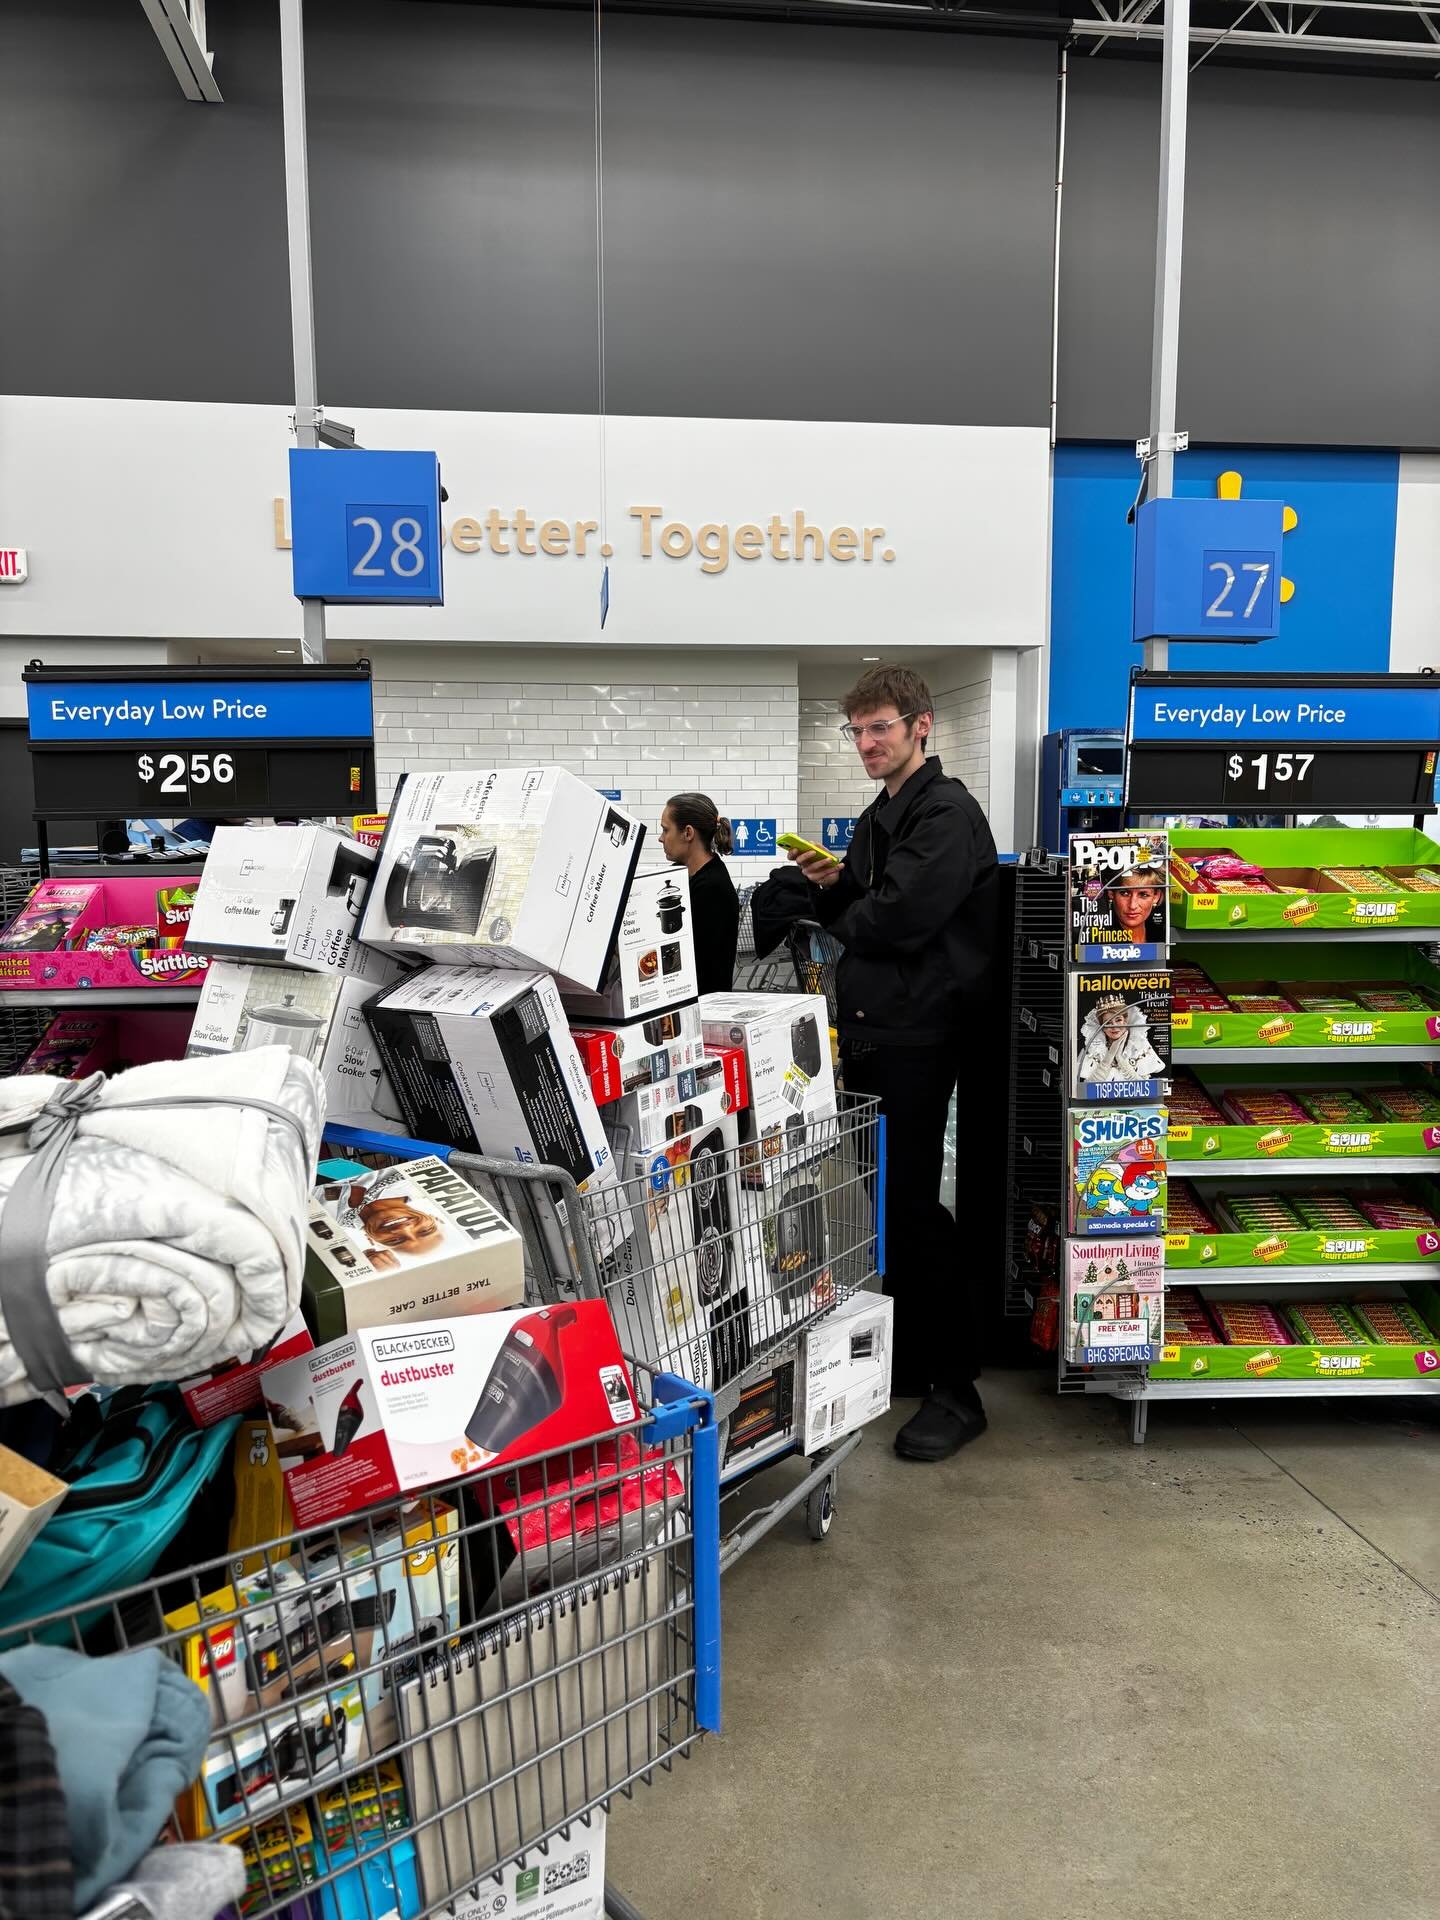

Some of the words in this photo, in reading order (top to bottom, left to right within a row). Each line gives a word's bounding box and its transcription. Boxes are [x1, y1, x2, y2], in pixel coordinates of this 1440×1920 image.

[352, 516, 425, 577] 28
[442, 508, 613, 557] etter.
[630, 506, 896, 573] Together.
[1206, 561, 1270, 618] 27
[51, 699, 155, 726] Everyday
[162, 701, 206, 720] Low
[212, 699, 267, 719] Price
[1154, 703, 1246, 728] Everyday
[1252, 704, 1291, 723] Low
[1297, 703, 1346, 723] Price
[475, 773, 497, 820] Cafeteria
[1073, 837, 1164, 877] People
[587, 894, 600, 923] Coffee
[594, 863, 608, 893] Maker
[1080, 897, 1098, 912] The
[1197, 898, 1215, 906] NEW
[224, 906, 241, 914] Coffee
[242, 907, 261, 916] Maker
[1283, 902, 1319, 920] Starburst
[1351, 915, 1372, 924] FRUIT
[1373, 915, 1399, 924] CHEWS
[302, 905, 319, 951] MAINSTAYS
[623, 927, 641, 936] Cooker
[1080, 927, 1092, 943] of
[1092, 927, 1133, 943] Princess
[317, 928, 333, 962] 12-Cup
[327, 928, 344, 966] Coffee
[337, 932, 353, 969] Maker
[1102, 945, 1141, 960] People
[140, 954, 209, 976] Skittles
[1080, 975, 1170, 992] halloween
[193, 1030, 208, 1039] Slow
[208, 1032, 229, 1043] Cooker
[1259, 1022, 1294, 1038] Starburst
[1327, 1035, 1348, 1043] FRUIT
[1349, 1034, 1376, 1043] CHEWS
[344, 1054, 365, 1066] Slow
[599, 1040, 609, 1068] FOREMAN
[337, 1064, 366, 1078] Cooker
[569, 1053, 585, 1092] Cookware
[754, 1070, 763, 1078] Air
[762, 1065, 775, 1076] Fryer
[455, 1060, 475, 1101] Cookware
[471, 1102, 482, 1117] Set
[603, 1068, 612, 1097] GEORGE
[1113, 1081, 1150, 1098] SPECIALS
[1081, 1116, 1161, 1144] SMURFS
[1171, 1130, 1188, 1138] NEW
[1257, 1134, 1292, 1149] Starburst
[1346, 1145, 1373, 1153] CHEWS
[600, 1146, 608, 1160] 10
[408, 1166, 510, 1241] PAPATUI
[1122, 1220, 1149, 1230] specials
[1072, 1243, 1123, 1260] Southern
[1125, 1242, 1161, 1260] Living
[1253, 1241, 1288, 1257] Starburst
[1428, 1238, 1437, 1248] S
[1320, 1252, 1341, 1260] FRUIT
[1342, 1251, 1368, 1259] CHEWS
[466, 1277, 491, 1293] TAKE
[422, 1286, 461, 1306] BETTER
[389, 1301, 416, 1315] CARE
[1119, 1324, 1140, 1332] YEAR!
[376, 1336, 451, 1356] BLACK+DECKER
[1087, 1348, 1107, 1363] BHG
[1108, 1345, 1151, 1362] SPECIALS
[311, 1344, 354, 1369] BLACK+DECKER
[1246, 1355, 1282, 1370] Starburst
[1426, 1355, 1436, 1366] S
[312, 1358, 356, 1384] dustbuster
[380, 1361, 455, 1387] dustbuster
[808, 1364, 828, 1379] Toaster
[828, 1359, 842, 1372] Oven
[1315, 1368, 1337, 1376] FRUIT
[1338, 1367, 1364, 1376] CHEWS
[468, 1903, 488, 1918] ONLY
